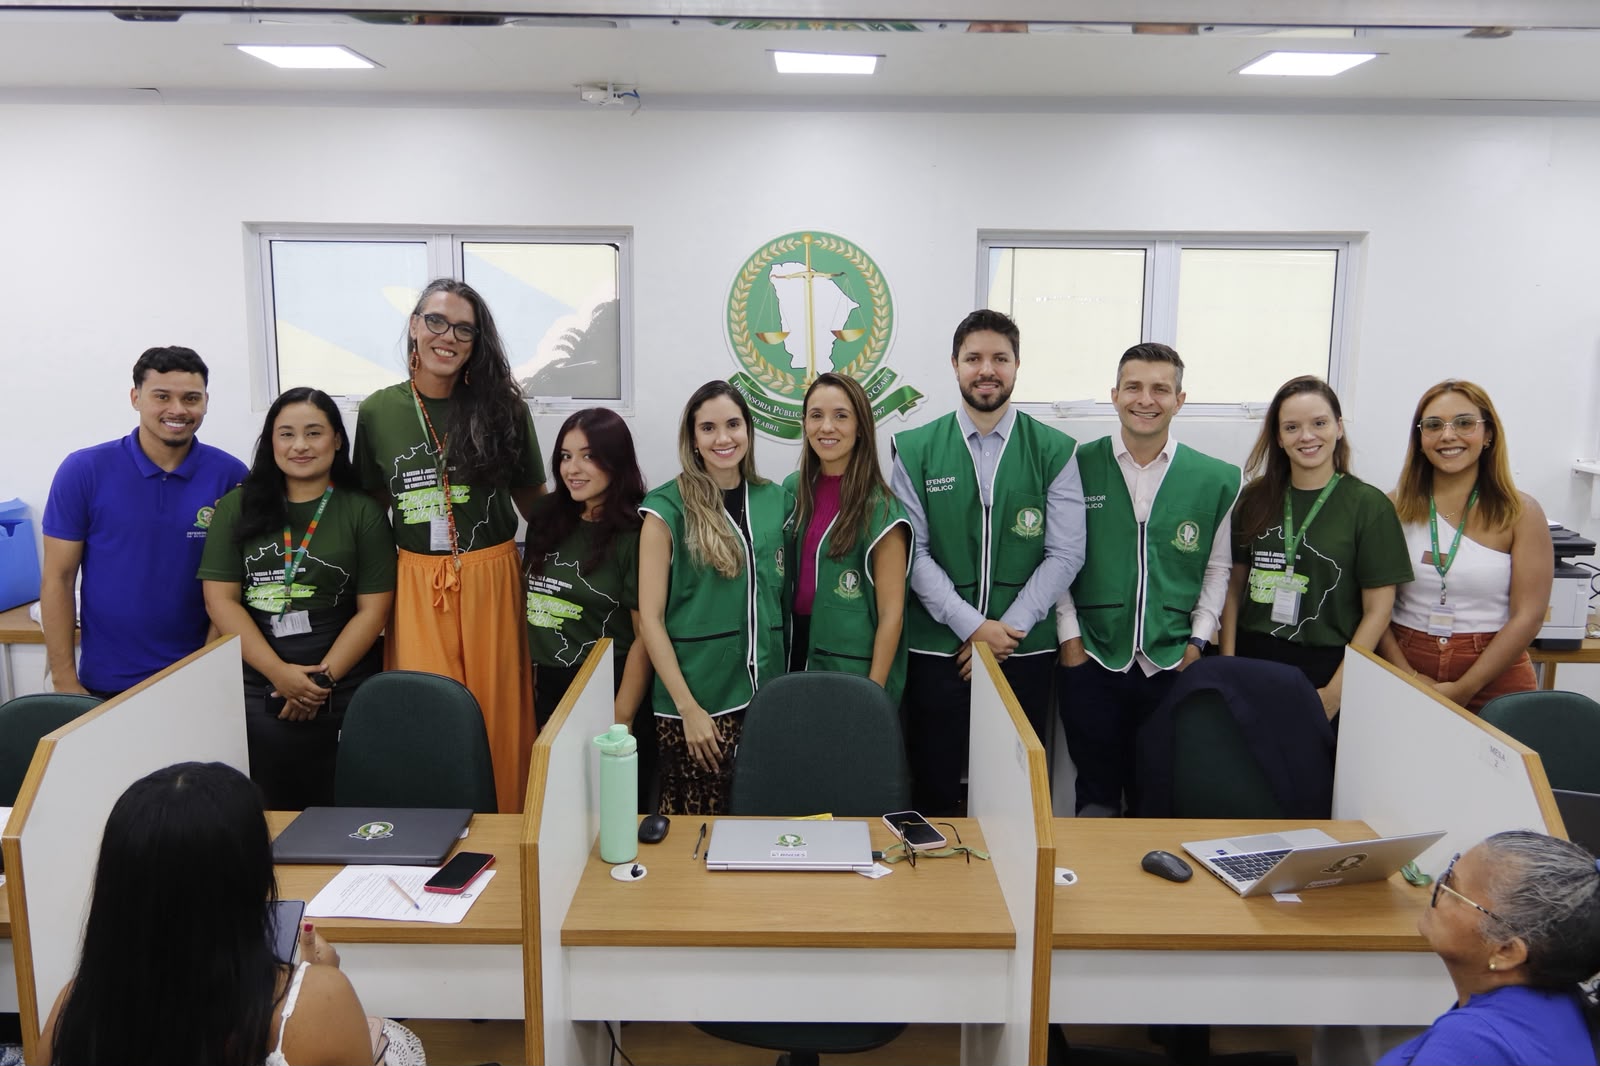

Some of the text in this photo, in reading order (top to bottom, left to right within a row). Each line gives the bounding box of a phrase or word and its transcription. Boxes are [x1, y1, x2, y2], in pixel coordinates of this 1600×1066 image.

[733, 380, 771, 412] DEFENSORIA
[773, 405, 804, 418] PÚBLIC
[872, 373, 893, 394] CEARÁ
[752, 406, 885, 433] DE ABRIL 997
[926, 476, 956, 486] EFENSOR
